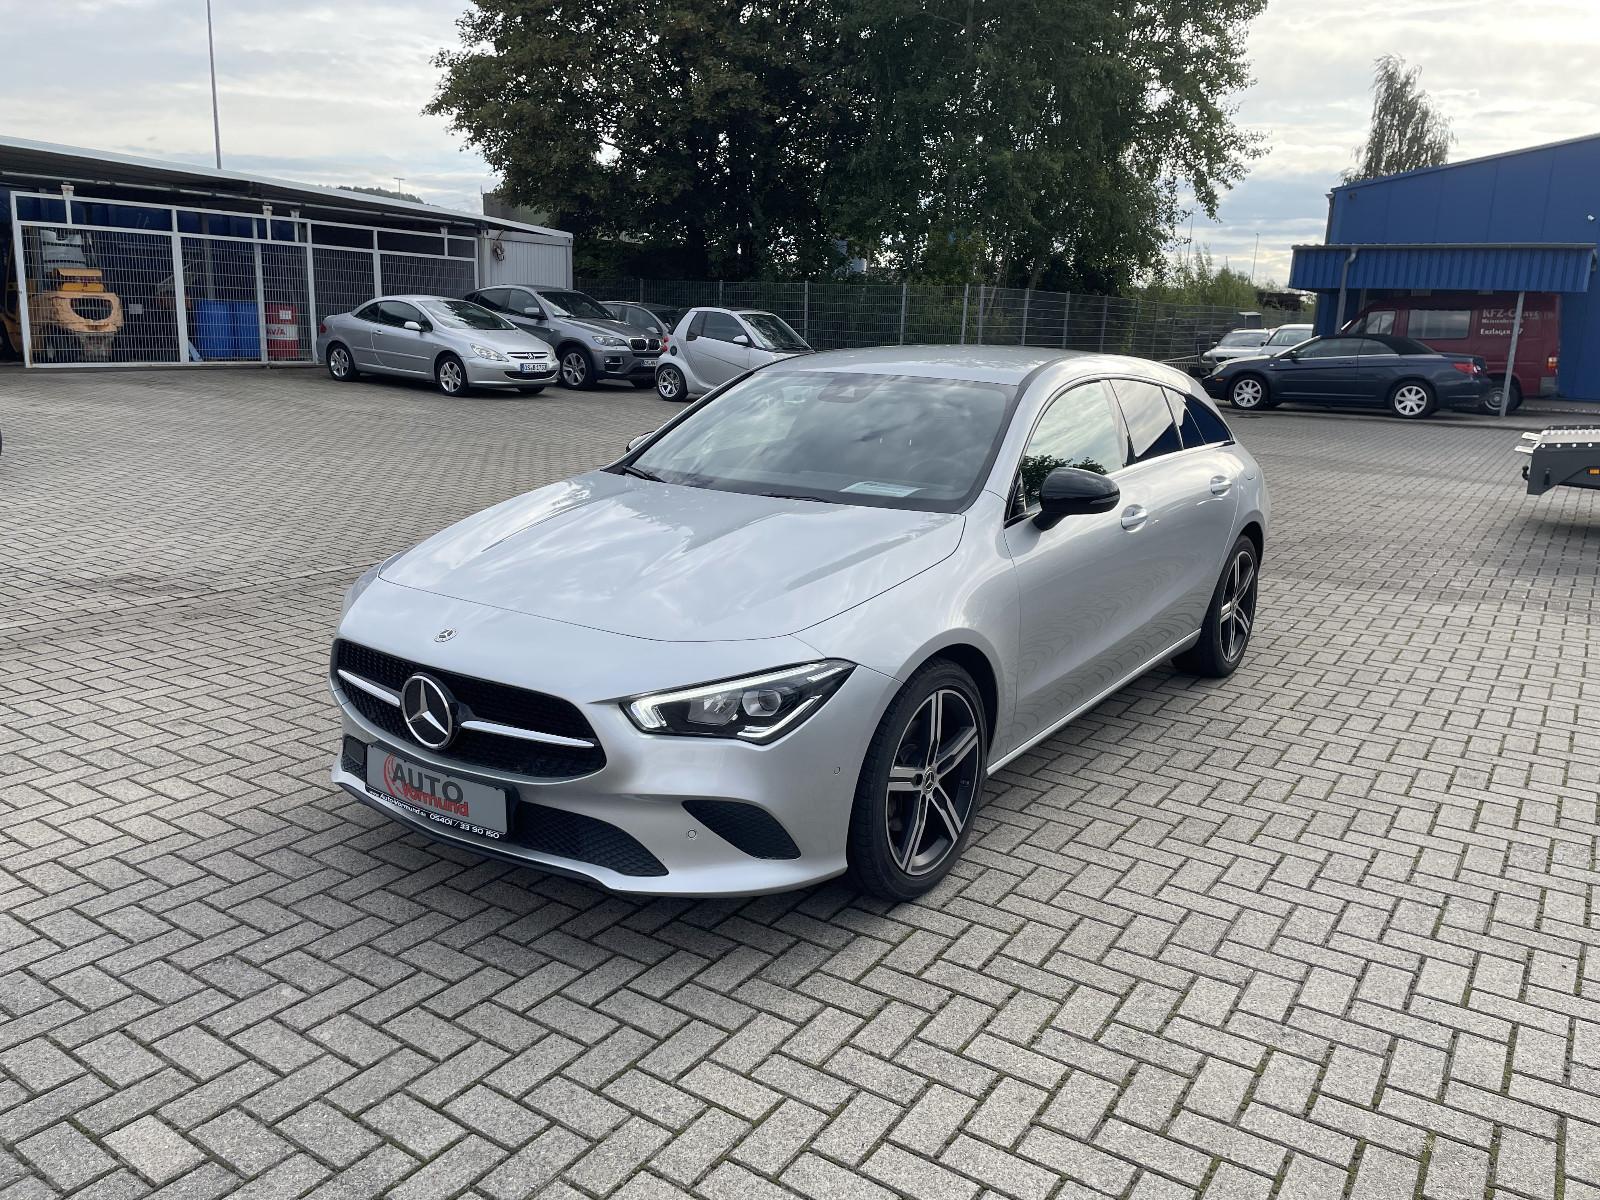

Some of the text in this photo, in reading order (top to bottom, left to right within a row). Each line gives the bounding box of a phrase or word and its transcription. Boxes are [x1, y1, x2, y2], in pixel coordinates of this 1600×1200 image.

[392, 763, 464, 803] AUTO
[399, 781, 469, 817] Vormund
[429, 812, 453, 826] 05401
[459, 822, 470, 832] 33
[472, 825, 484, 836] 90
[485, 829, 500, 840] 150
